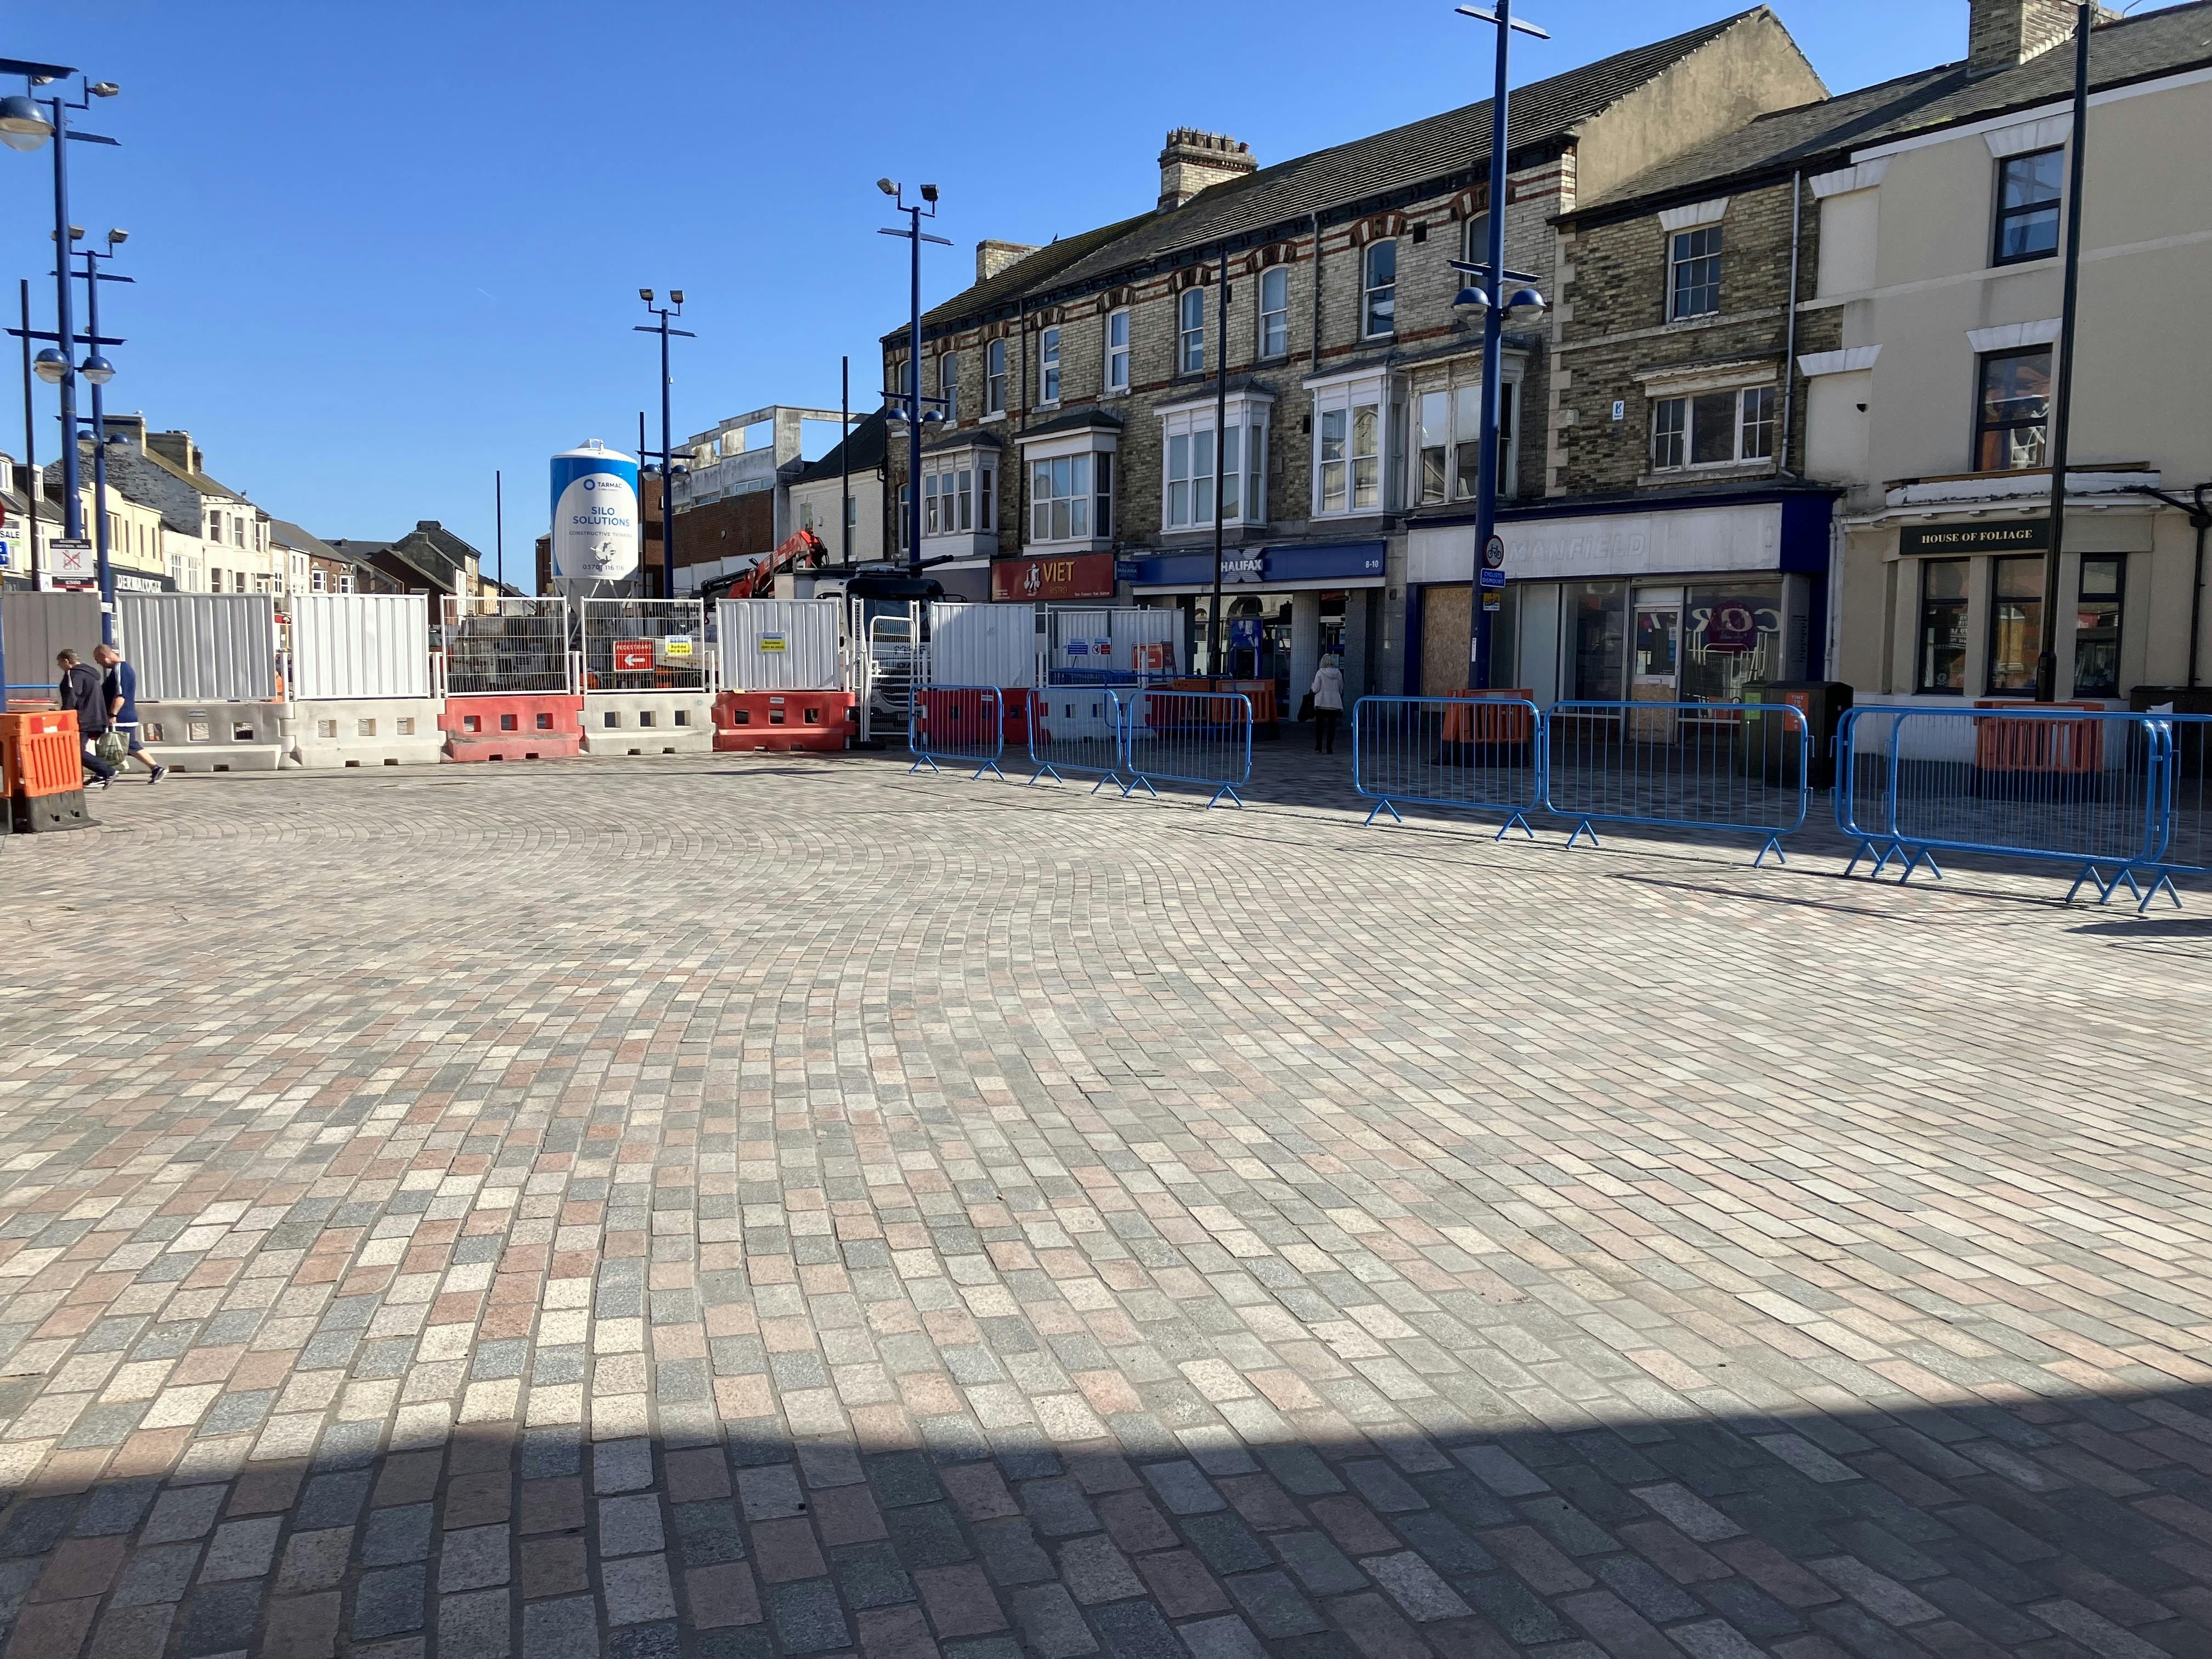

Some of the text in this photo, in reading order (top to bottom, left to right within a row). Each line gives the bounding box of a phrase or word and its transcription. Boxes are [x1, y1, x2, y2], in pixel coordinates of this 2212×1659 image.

[591, 506, 615, 516] SILO
[573, 516, 630, 527] SOLUTIONS
[0, 531, 20, 539] SALE
[1922, 529, 2033, 544] HOUSE OF FOLIAGE
[1508, 534, 1646, 562] MANFIELD
[1221, 559, 1263, 572] HALIFAX
[1365, 560, 1379, 568] 8-10
[1043, 561, 1076, 583] VIET
[115, 574, 162, 593] DERMALOGIX
[1049, 586, 1068, 595] BISTRO
